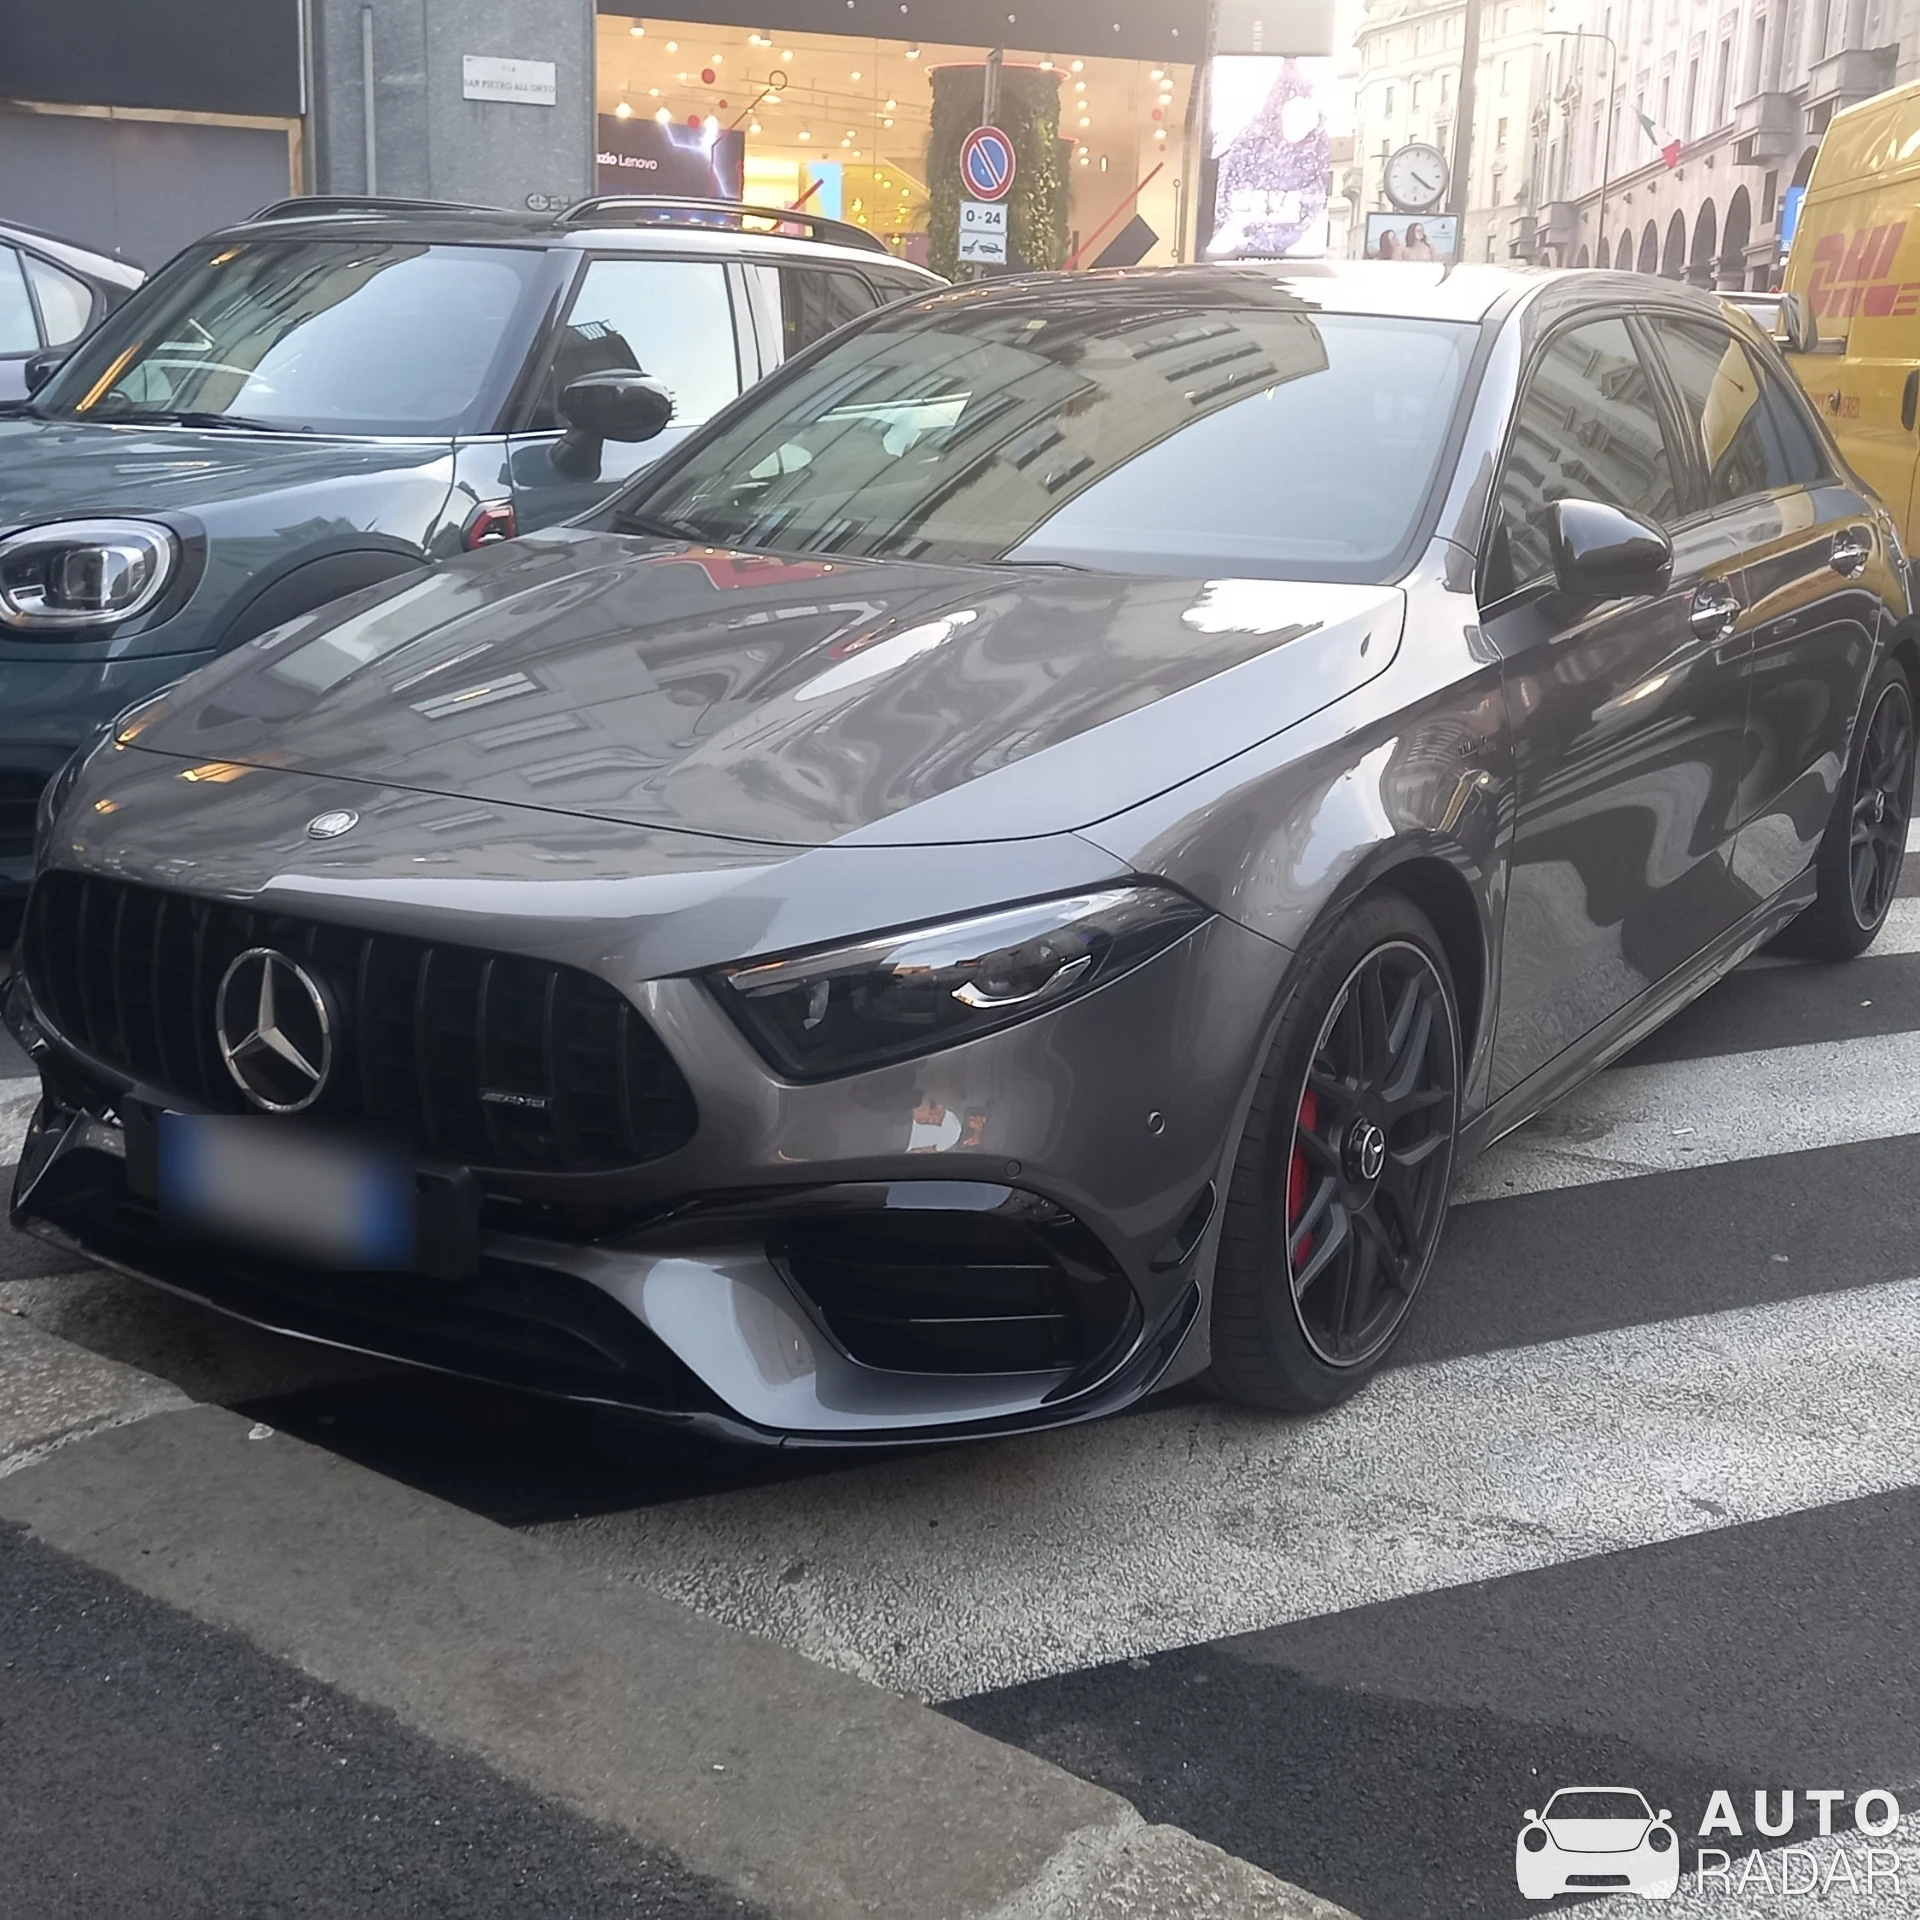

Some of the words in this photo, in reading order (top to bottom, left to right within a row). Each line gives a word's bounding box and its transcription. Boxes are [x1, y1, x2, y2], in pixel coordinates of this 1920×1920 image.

[482, 80, 513, 90] PIETRO
[618, 153, 658, 170] Lenovo
[1807, 221, 1907, 319] DHL
